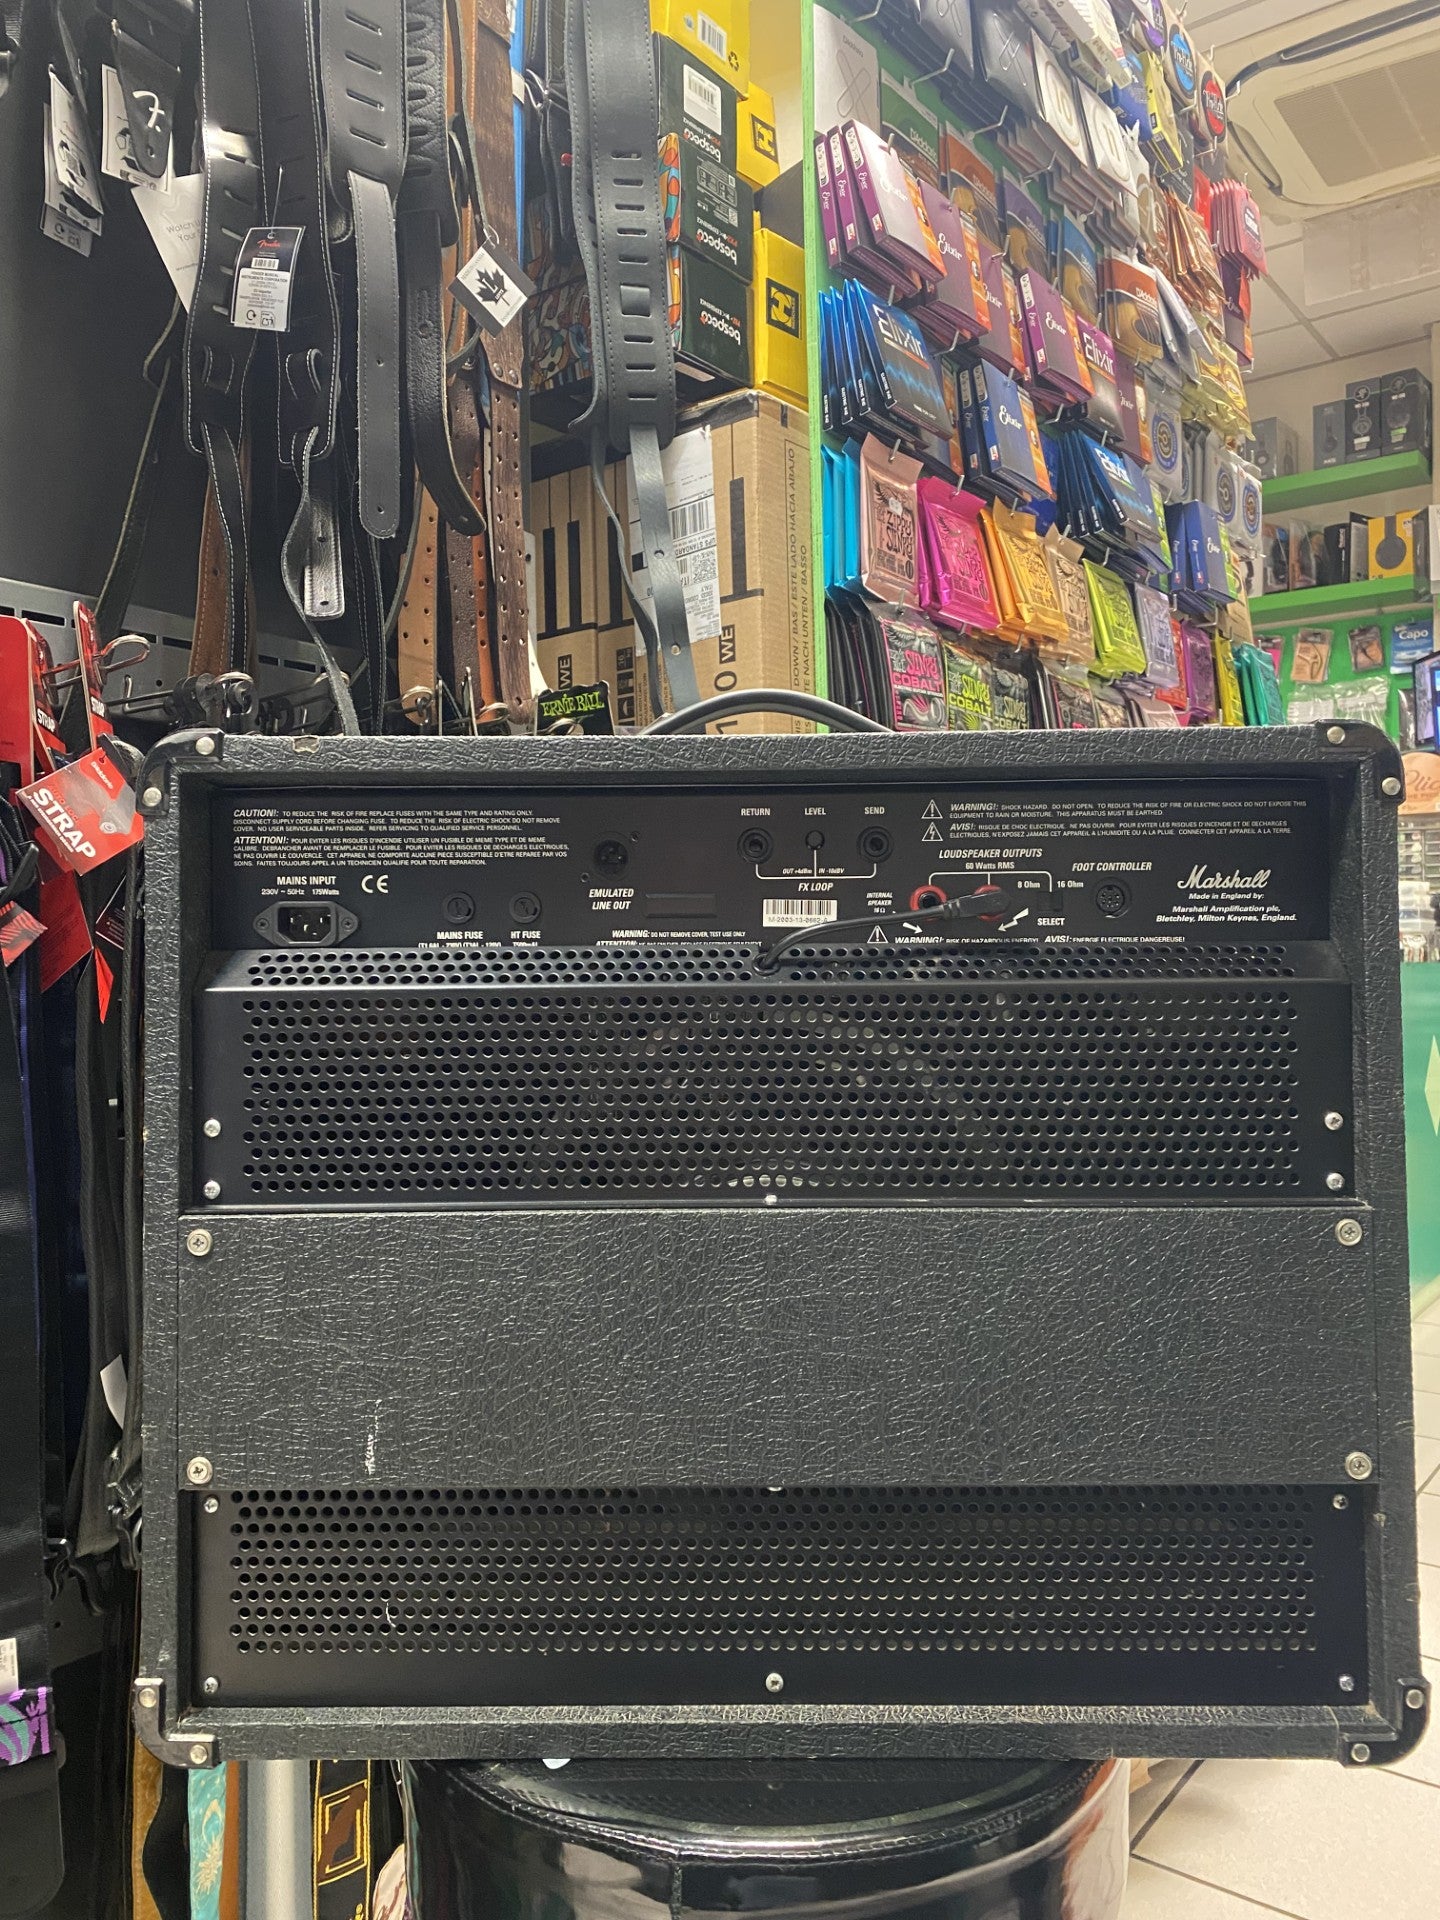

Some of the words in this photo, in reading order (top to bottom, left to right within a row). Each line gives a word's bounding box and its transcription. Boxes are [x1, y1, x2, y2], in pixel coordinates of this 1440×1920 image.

[683, 127, 721, 163] bespeco
[696, 228, 738, 265] bespeco
[937, 232, 963, 261] Elixir
[700, 309, 741, 345] bespeco
[872, 303, 928, 362] Elixir
[1045, 311, 1067, 336] Elixir
[1083, 331, 1116, 377] Elixir
[999, 404, 1023, 430] Elixir
[787, 448, 796, 489] ABAJO
[788, 493, 797, 531] HACIA
[886, 508, 912, 537] ZIPPY
[674, 541, 703, 556] STANDARD
[704, 537, 716, 548] UPS
[789, 533, 797, 569] LADO
[886, 525, 913, 561] SLINKY
[800, 545, 808, 586] BASSO
[790, 572, 798, 600] ESTE
[791, 608, 799, 634] BAS
[802, 595, 810, 638] UNTEN
[720, 626, 735, 660] WE
[1399, 629, 1429, 640] Capo
[793, 646, 801, 687] DOWN
[803, 640, 811, 677] NACH
[904, 650, 940, 680] SLINKY
[560, 657, 571, 688] WE
[892, 671, 942, 693] COBALT
[961, 673, 991, 705] SLINKY
[90, 695, 105, 718] STRAP
[540, 692, 576, 717] ERNIE
[575, 690, 605, 712] BALL
[949, 692, 993, 718] COBALT
[37, 707, 56, 733] STRAP
[233, 809, 279, 817] CAUTION!:
[740, 808, 771, 816] RETURN
[804, 807, 826, 815] LEVEL
[864, 806, 885, 815] SEND
[950, 803, 999, 811] WARNING!:
[33, 787, 97, 859] STRAP
[950, 823, 974, 831] AVIS!:
[234, 836, 290, 845] ATTENTION!:
[939, 850, 1000, 859] LOUDSPEAKER
[1002, 848, 1043, 858] OUTPUTS
[1072, 863, 1095, 871] FOOT
[1096, 862, 1152, 871] CONTROLLER
[1177, 864, 1271, 889] Marshall
[276, 876, 307, 885] MAINS
[309, 876, 336, 885] INPUT
[589, 888, 634, 898] EMULATED
[798, 883, 809, 891] FX
[810, 882, 834, 891] LOOP
[592, 901, 612, 910] LINE
[612, 901, 631, 910] OUT
[1156, 914, 1196, 923] Bletchley,
[1198, 914, 1226, 922] Milton
[1227, 914, 1259, 922] Keynes,
[1261, 914, 1297, 922] England.
[1209, 906, 1264, 914] Amplification
[510, 931, 520, 939] HT
[522, 931, 541, 939] FUSE
[612, 930, 650, 938] WARNING:
[1037, 918, 1065, 926] SELECT
[436, 931, 462, 940] MAINS
[464, 931, 483, 939] FUSE
